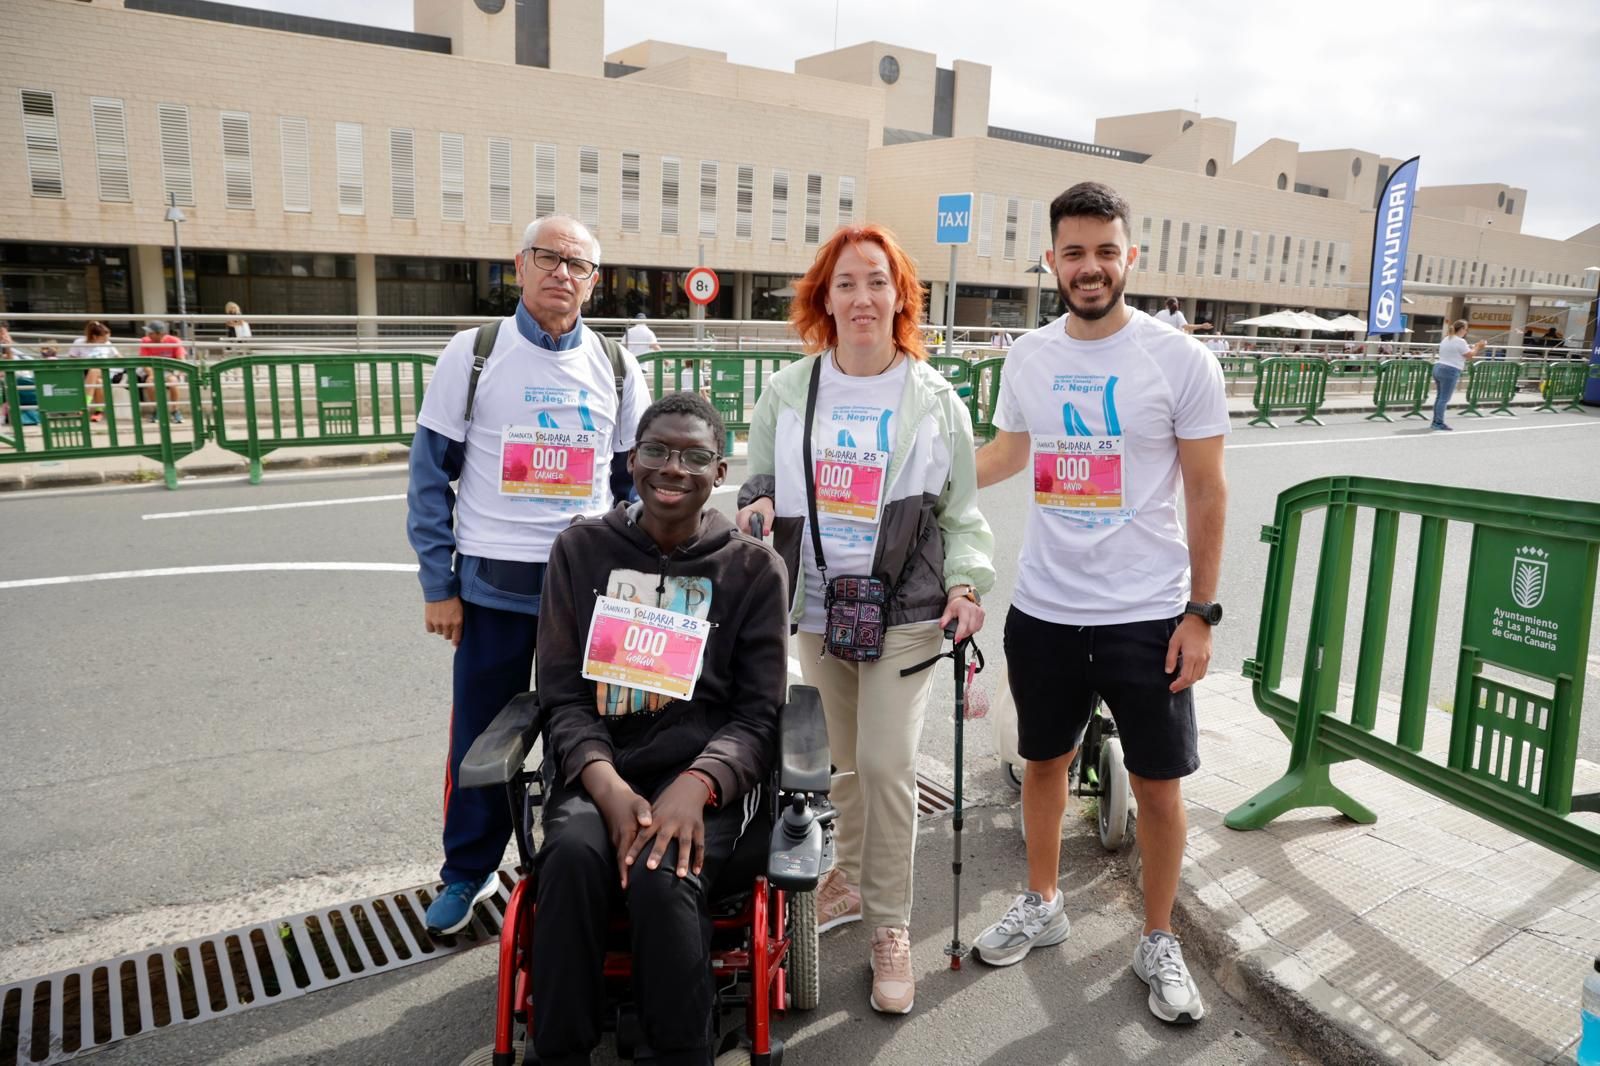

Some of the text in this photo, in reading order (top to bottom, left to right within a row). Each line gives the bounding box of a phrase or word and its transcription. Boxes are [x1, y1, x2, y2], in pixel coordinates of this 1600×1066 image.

[938, 211, 969, 227] TAXI
[1381, 182, 1407, 286] HYUNDAI
[696, 280, 708, 292] 8t
[536, 431, 570, 443] SOLIDARIA
[1057, 440, 1092, 451] SOLIDARIA
[1098, 441, 1112, 449] 25
[533, 448, 568, 470] 000
[825, 448, 857, 460] SOLIDARIA
[864, 452, 876, 461] 25
[535, 470, 564, 479] CARMELO
[821, 464, 852, 488] 000
[1056, 457, 1090, 480] 000
[1063, 482, 1082, 490] DAVID
[603, 604, 631, 615] CAMINATA
[634, 608, 674, 626] SOLIDARIA
[682, 619, 697, 630] 25
[1494, 608, 1559, 630] Ayuntamiento
[1492, 618, 1558, 641] de Las Palmas
[1492, 627, 1556, 651] de Gran Canaria
[624, 626, 668, 656] 000
[626, 653, 655, 666] GORGUI
